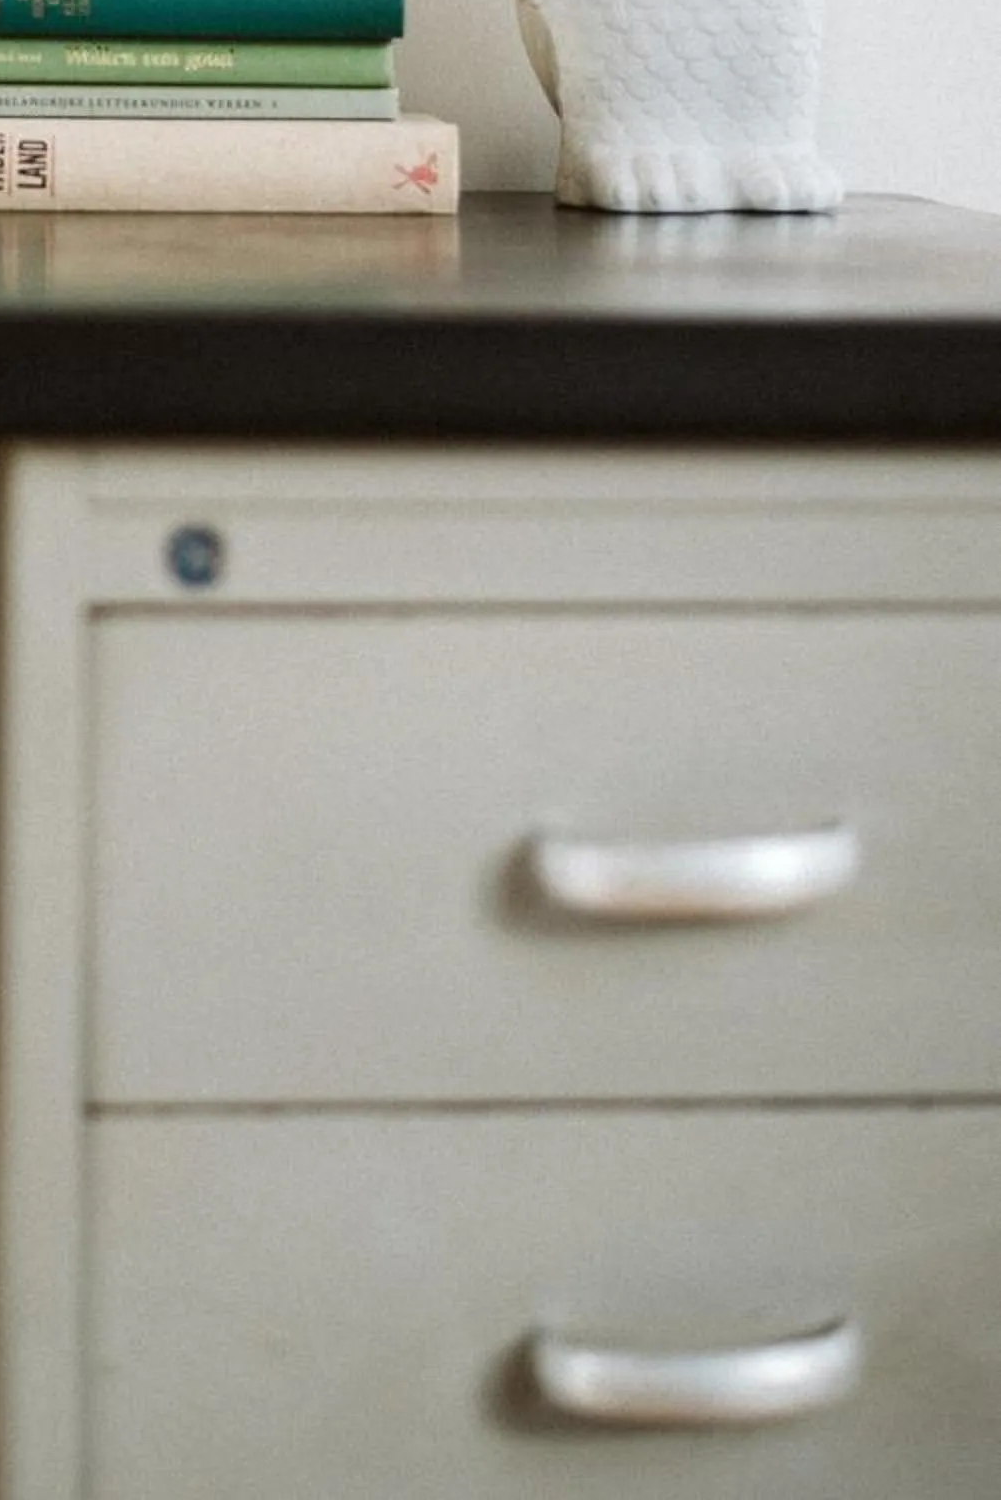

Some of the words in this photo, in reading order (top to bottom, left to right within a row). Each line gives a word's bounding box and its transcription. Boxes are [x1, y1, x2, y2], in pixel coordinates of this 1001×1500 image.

[88, 97, 201, 110] LETTERKUNDIGE
[205, 99, 262, 110] WERKEN
[16, 139, 48, 189] LAND
